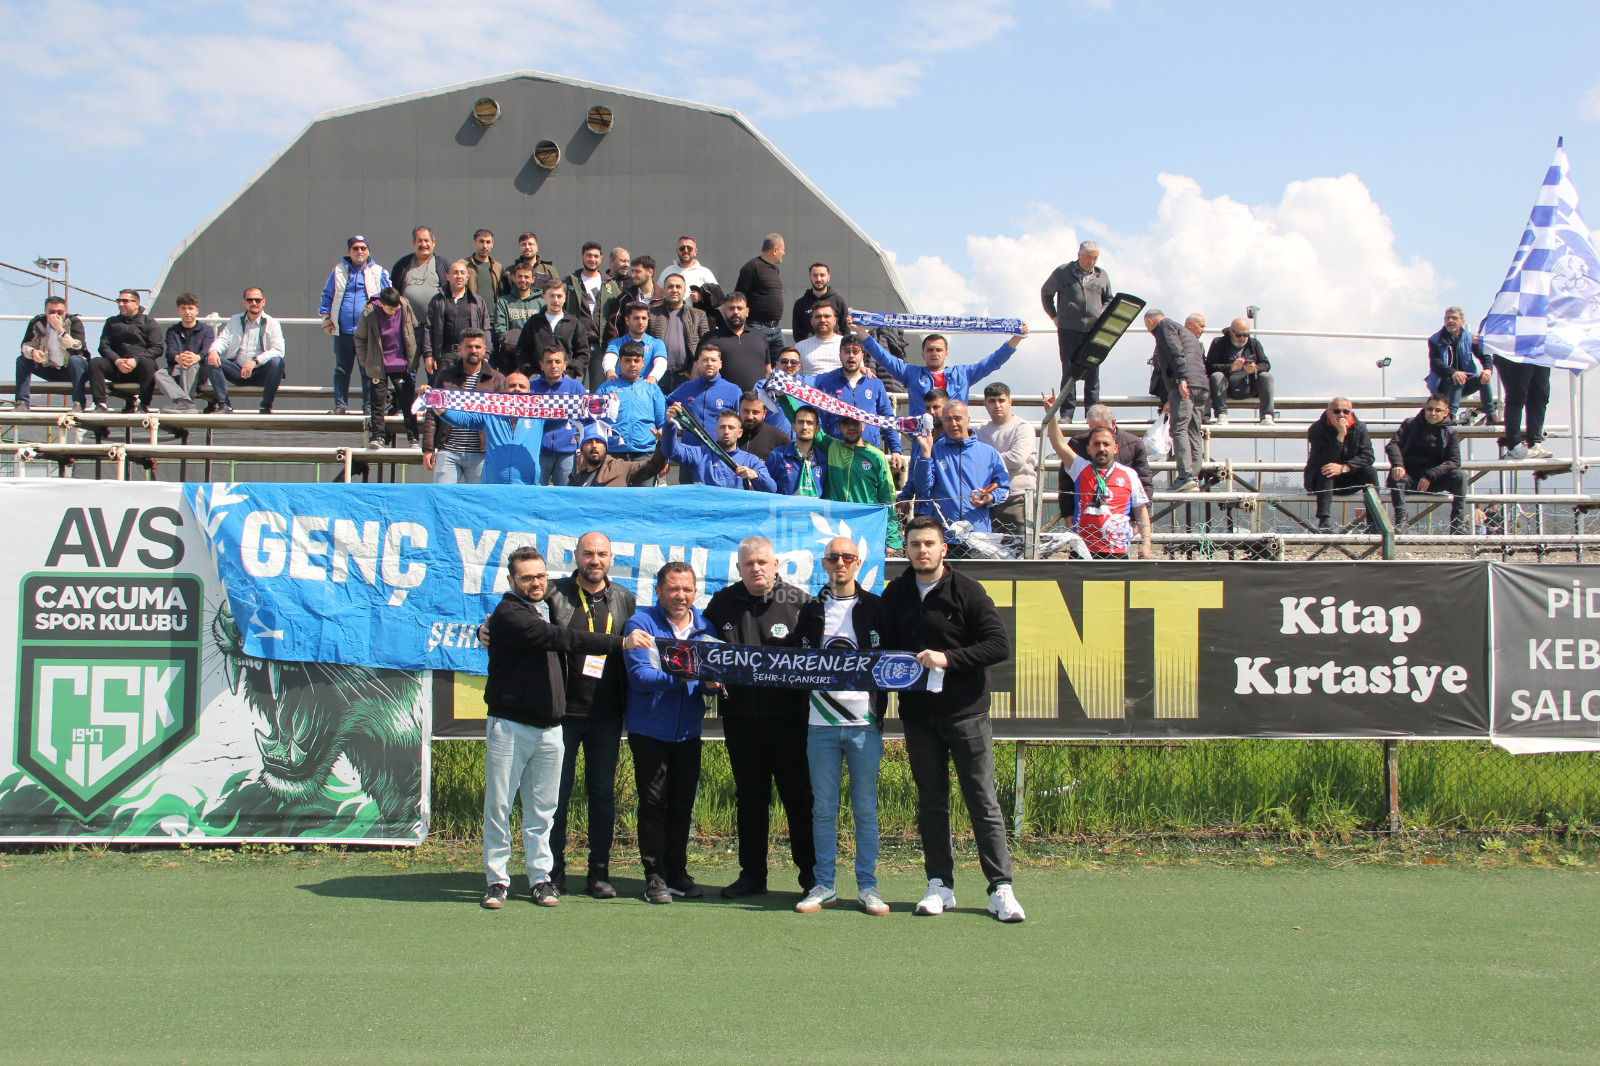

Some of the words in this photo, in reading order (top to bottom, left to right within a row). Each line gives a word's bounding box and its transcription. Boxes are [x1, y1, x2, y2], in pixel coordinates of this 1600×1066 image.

[463, 402, 567, 418] YARENLER
[488, 393, 543, 407] GENÇ
[45, 507, 185, 569] AVS
[241, 510, 428, 606] GENÇ
[35, 613, 95, 630] SPOR
[1279, 596, 1422, 643] Kitap
[428, 621, 481, 652] ŞEH
[707, 648, 762, 672] GENÇ
[768, 653, 872, 672] YARENLER
[788, 675, 831, 684] ÇANKIRI
[1233, 655, 1468, 703] Kırtasiye
[72, 728, 104, 742] 1947
